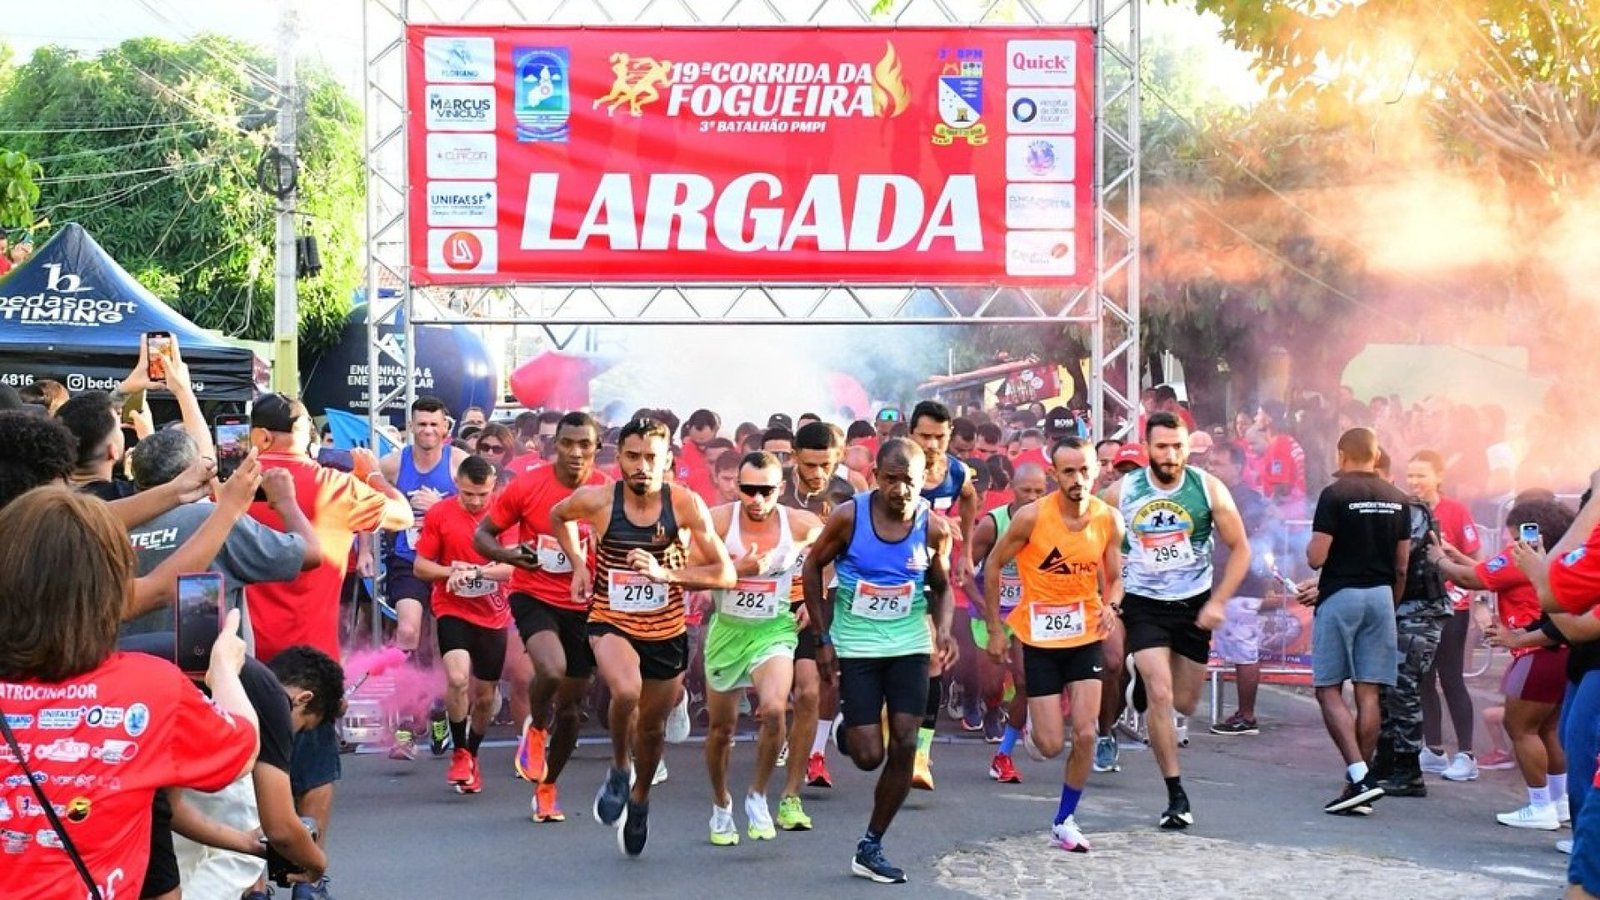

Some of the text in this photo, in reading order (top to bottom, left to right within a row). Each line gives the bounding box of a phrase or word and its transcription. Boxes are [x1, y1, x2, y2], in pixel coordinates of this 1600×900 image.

[1013, 52, 1066, 70] Quick
[837, 63, 872, 83] DA
[431, 99, 491, 110] MARCUS
[667, 84, 875, 117] FOGUEIRA
[437, 110, 486, 118] VINICIUS
[717, 118, 788, 132] BATALHÃO
[790, 121, 826, 132] PMPI
[431, 195, 485, 205] UNIFAESF
[519, 172, 984, 253] LARGADA
[0, 308, 123, 324] TIMING
[1, 374, 34, 386] 4816
[424, 367, 432, 378] &
[347, 376, 434, 388] ENEGIA SLAR
[131, 527, 178, 547] TECH
[557, 552, 566, 566] 9
[1154, 544, 1179, 562] 296
[624, 585, 654, 601] 279
[1000, 585, 1020, 598] 261
[736, 592, 765, 608] 282
[869, 597, 898, 611] 276
[1045, 613, 1071, 630] 262
